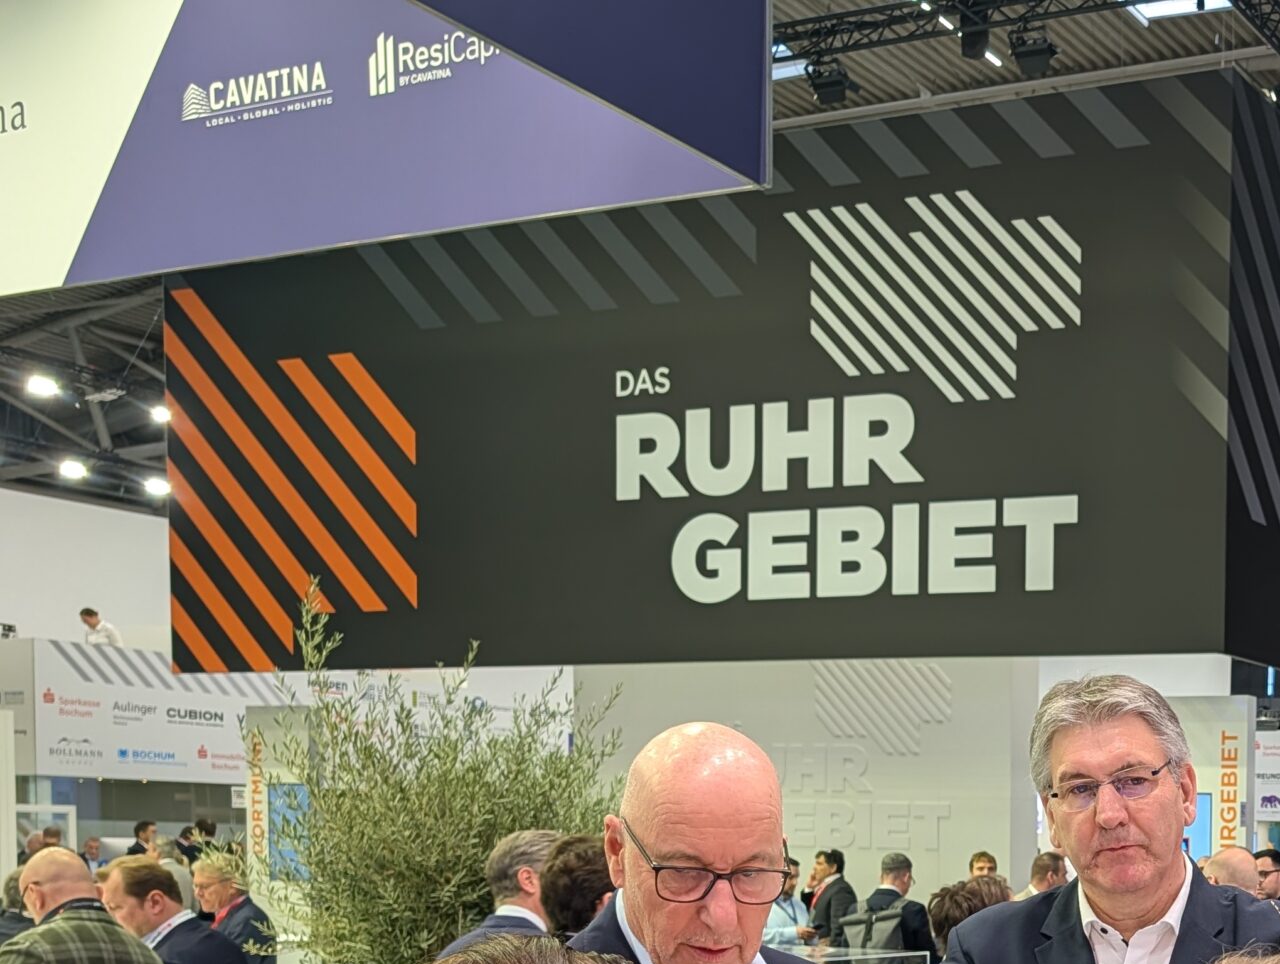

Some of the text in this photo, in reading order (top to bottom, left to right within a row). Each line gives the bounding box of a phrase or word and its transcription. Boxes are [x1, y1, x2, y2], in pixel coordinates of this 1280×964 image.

[209, 61, 326, 110] CAVATINA
[411, 68, 452, 84] CAVATINA
[206, 97, 333, 127] LOCAL GLOBAL HOLISTIC
[615, 367, 670, 397] DAS
[616, 393, 925, 501] RUHR
[671, 494, 1079, 604] GEBIET
[58, 697, 101, 708] Sparkasse
[58, 707, 93, 718] Bochum
[112, 701, 157, 716] Aulinger
[166, 707, 224, 722] CUBION
[131, 750, 176, 760] BOCHUM
[1220, 730, 1239, 849] RGEBIET
[785, 801, 951, 852] EBIET
